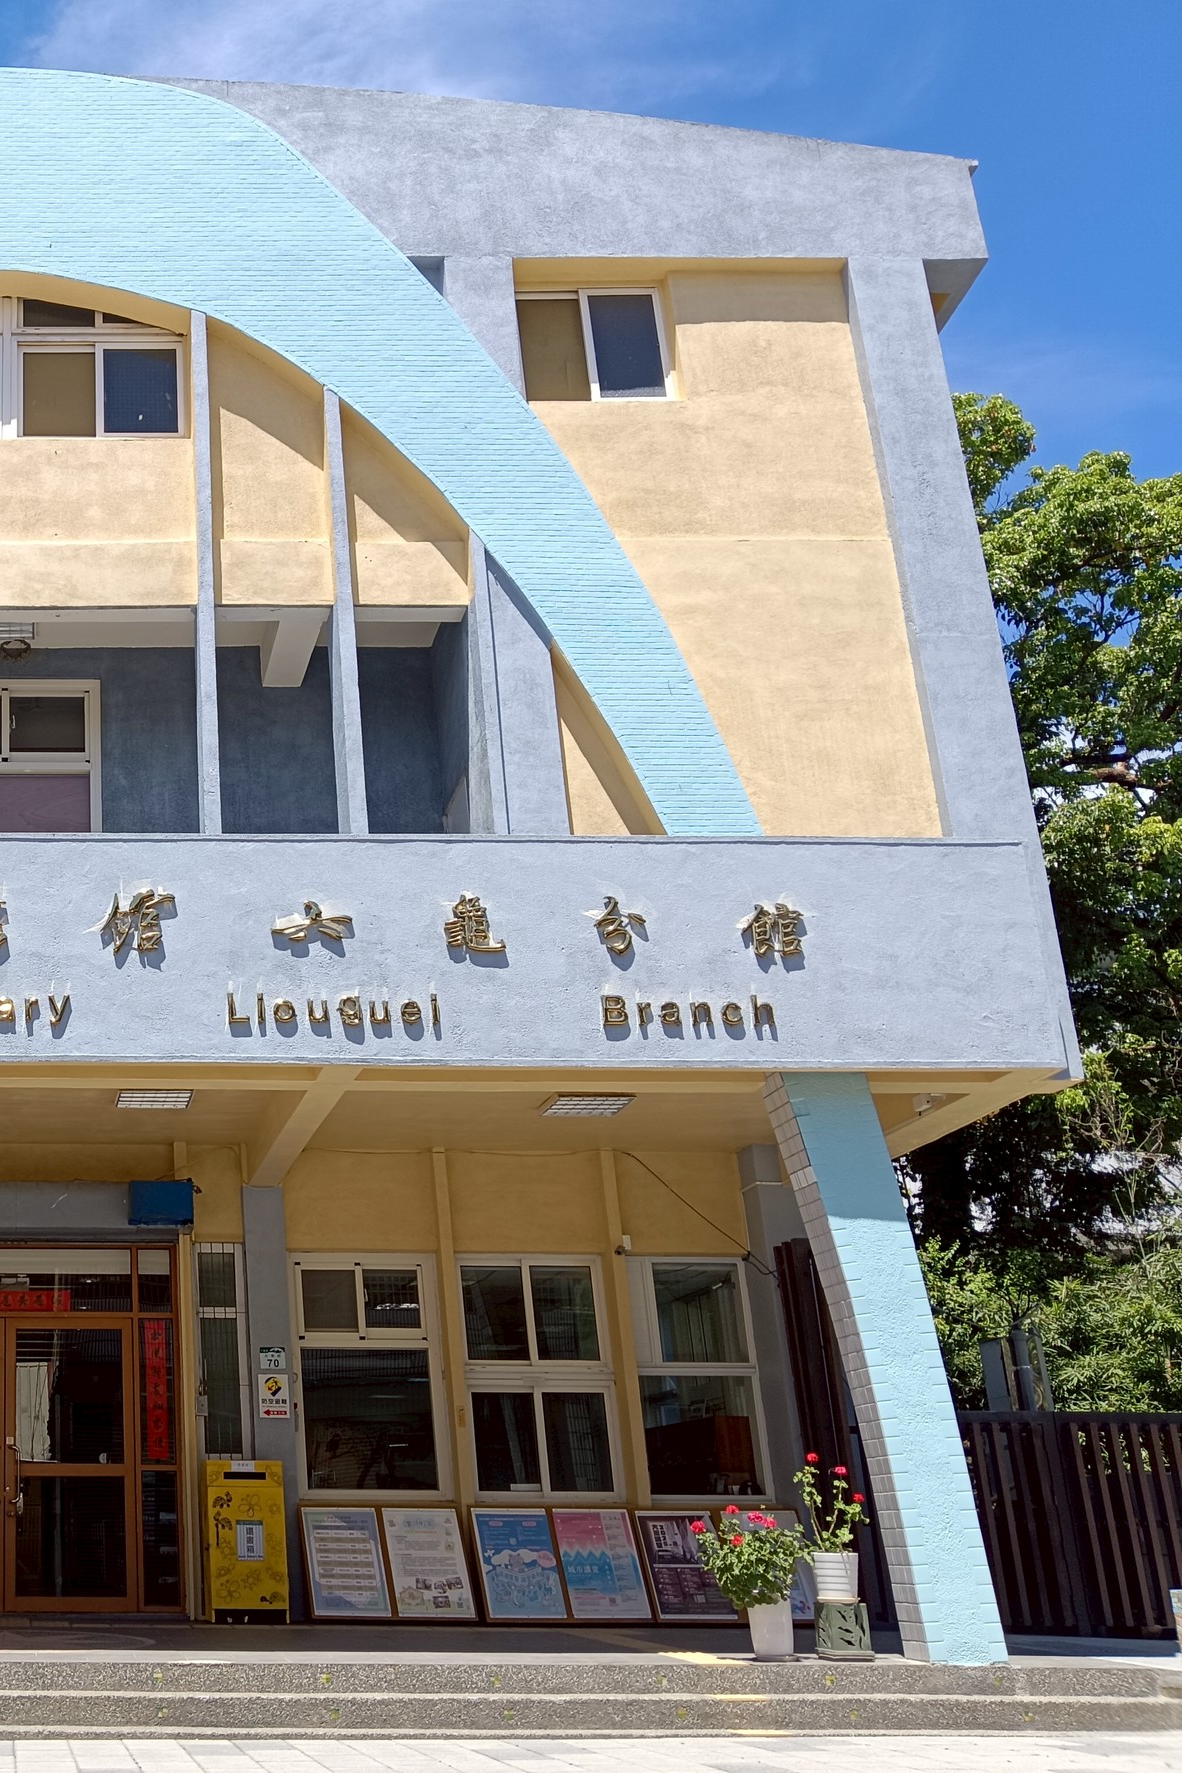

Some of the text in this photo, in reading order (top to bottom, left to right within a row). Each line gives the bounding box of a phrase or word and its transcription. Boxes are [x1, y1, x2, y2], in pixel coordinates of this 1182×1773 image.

[227, 992, 441, 1027] Liouguei
[601, 994, 775, 1027] Branch
[267, 1359, 280, 1368] 70
